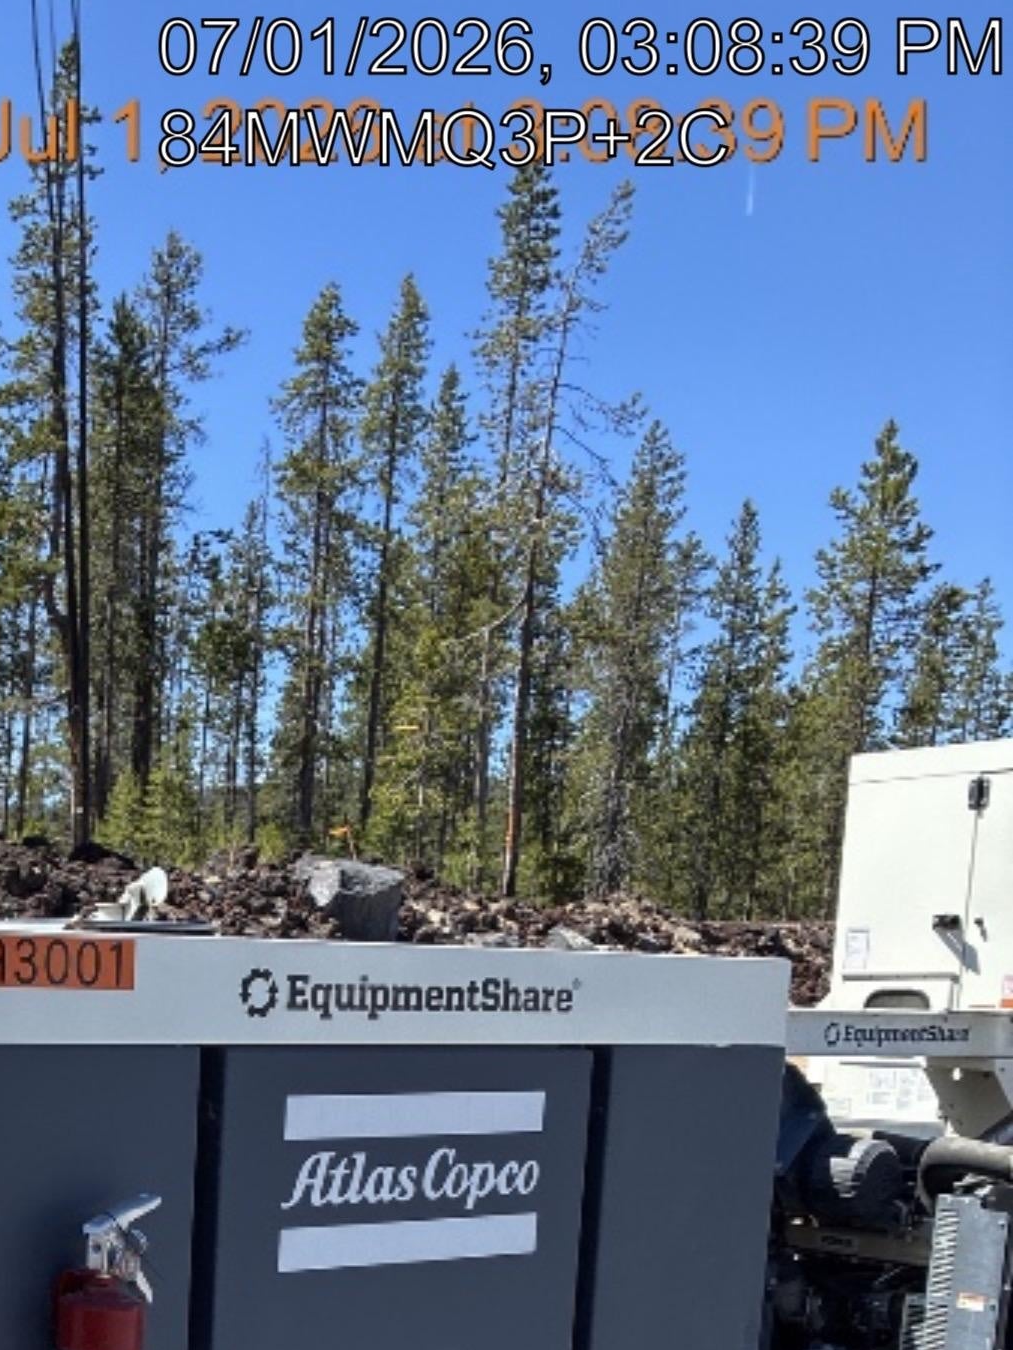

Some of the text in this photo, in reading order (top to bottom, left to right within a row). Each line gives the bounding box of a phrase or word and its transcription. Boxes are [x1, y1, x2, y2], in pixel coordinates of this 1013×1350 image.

[286, 973, 575, 1020] EquipmentShare
[280, 1146, 540, 1210] Atlas Copco
